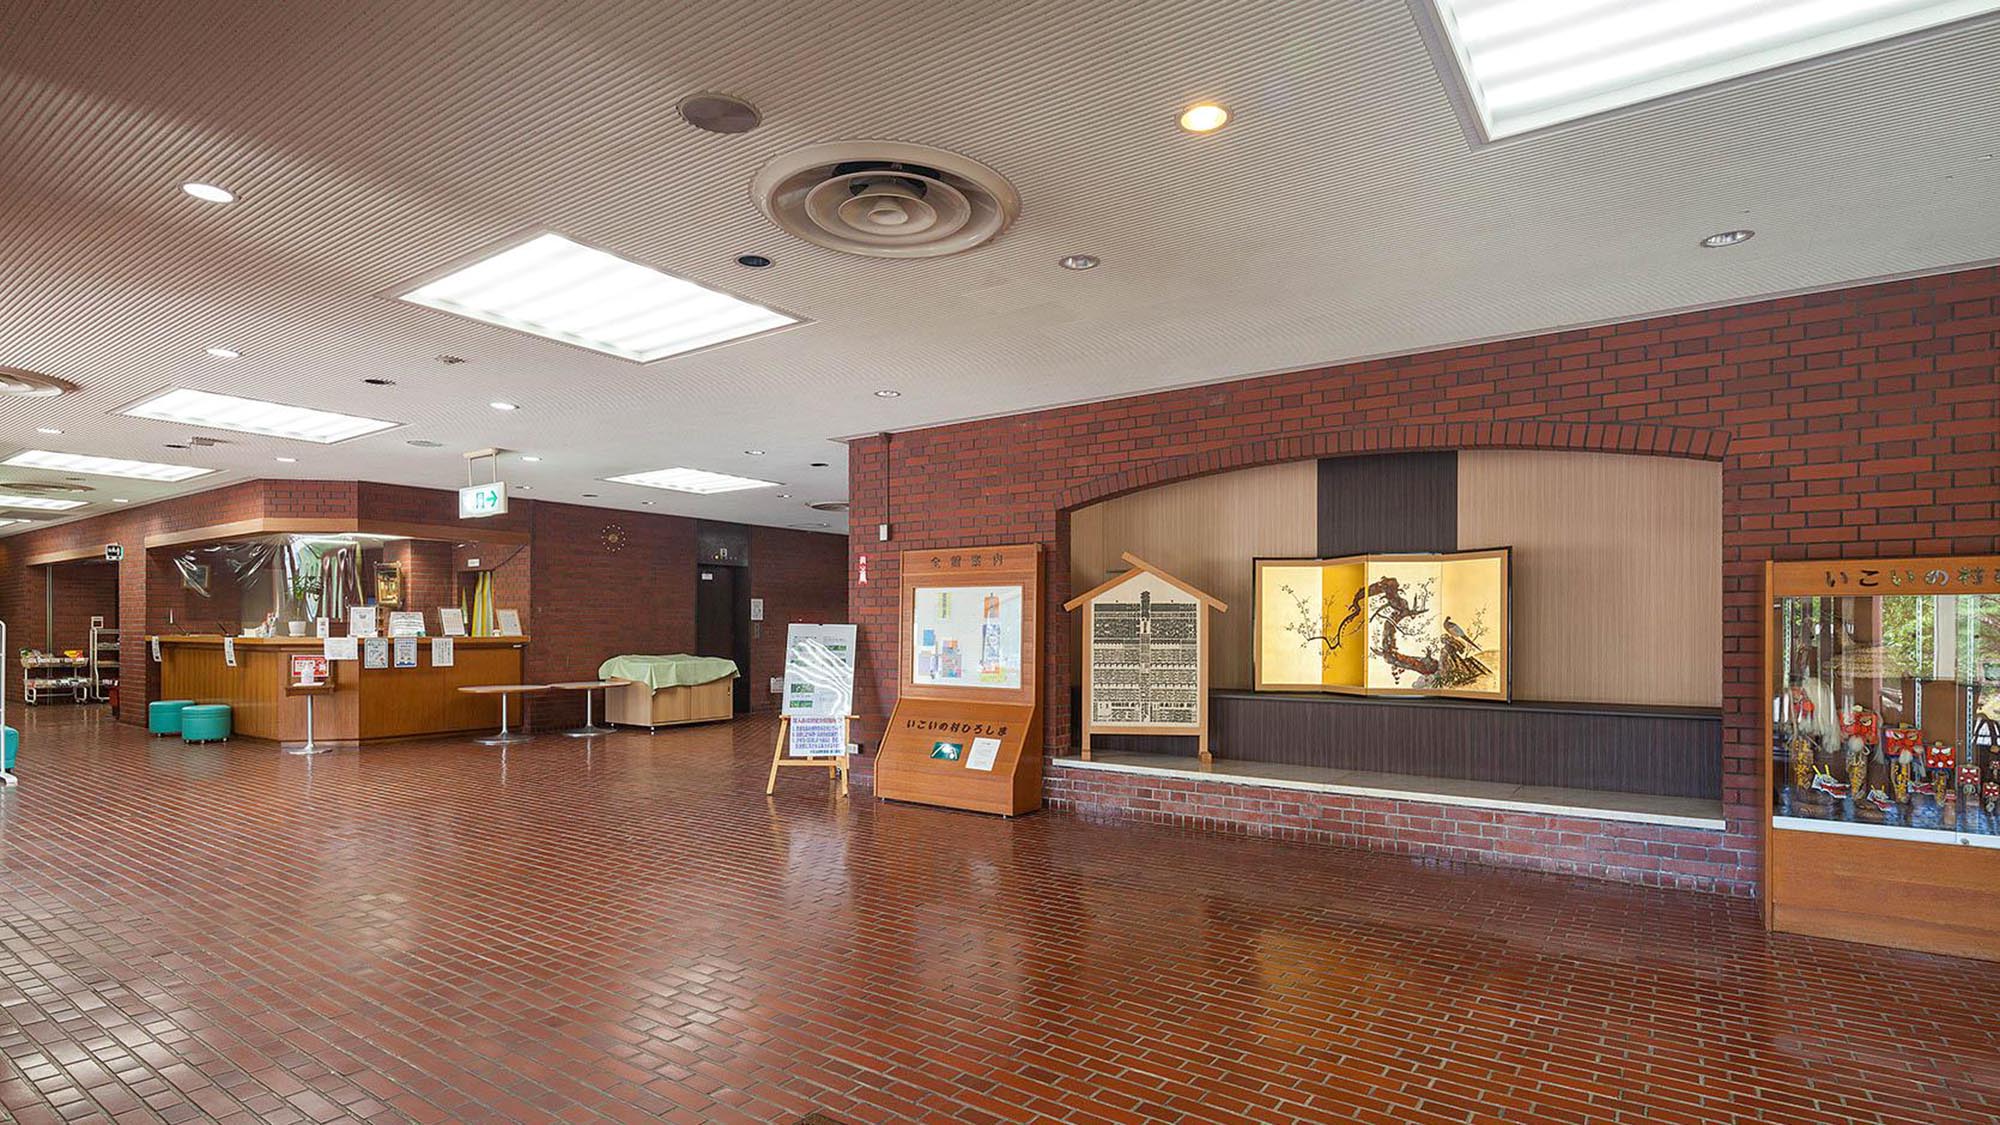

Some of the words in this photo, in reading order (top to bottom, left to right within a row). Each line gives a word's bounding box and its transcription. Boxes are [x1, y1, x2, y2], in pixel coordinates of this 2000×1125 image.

[906, 719, 1009, 737] いこいの村ひろしま
